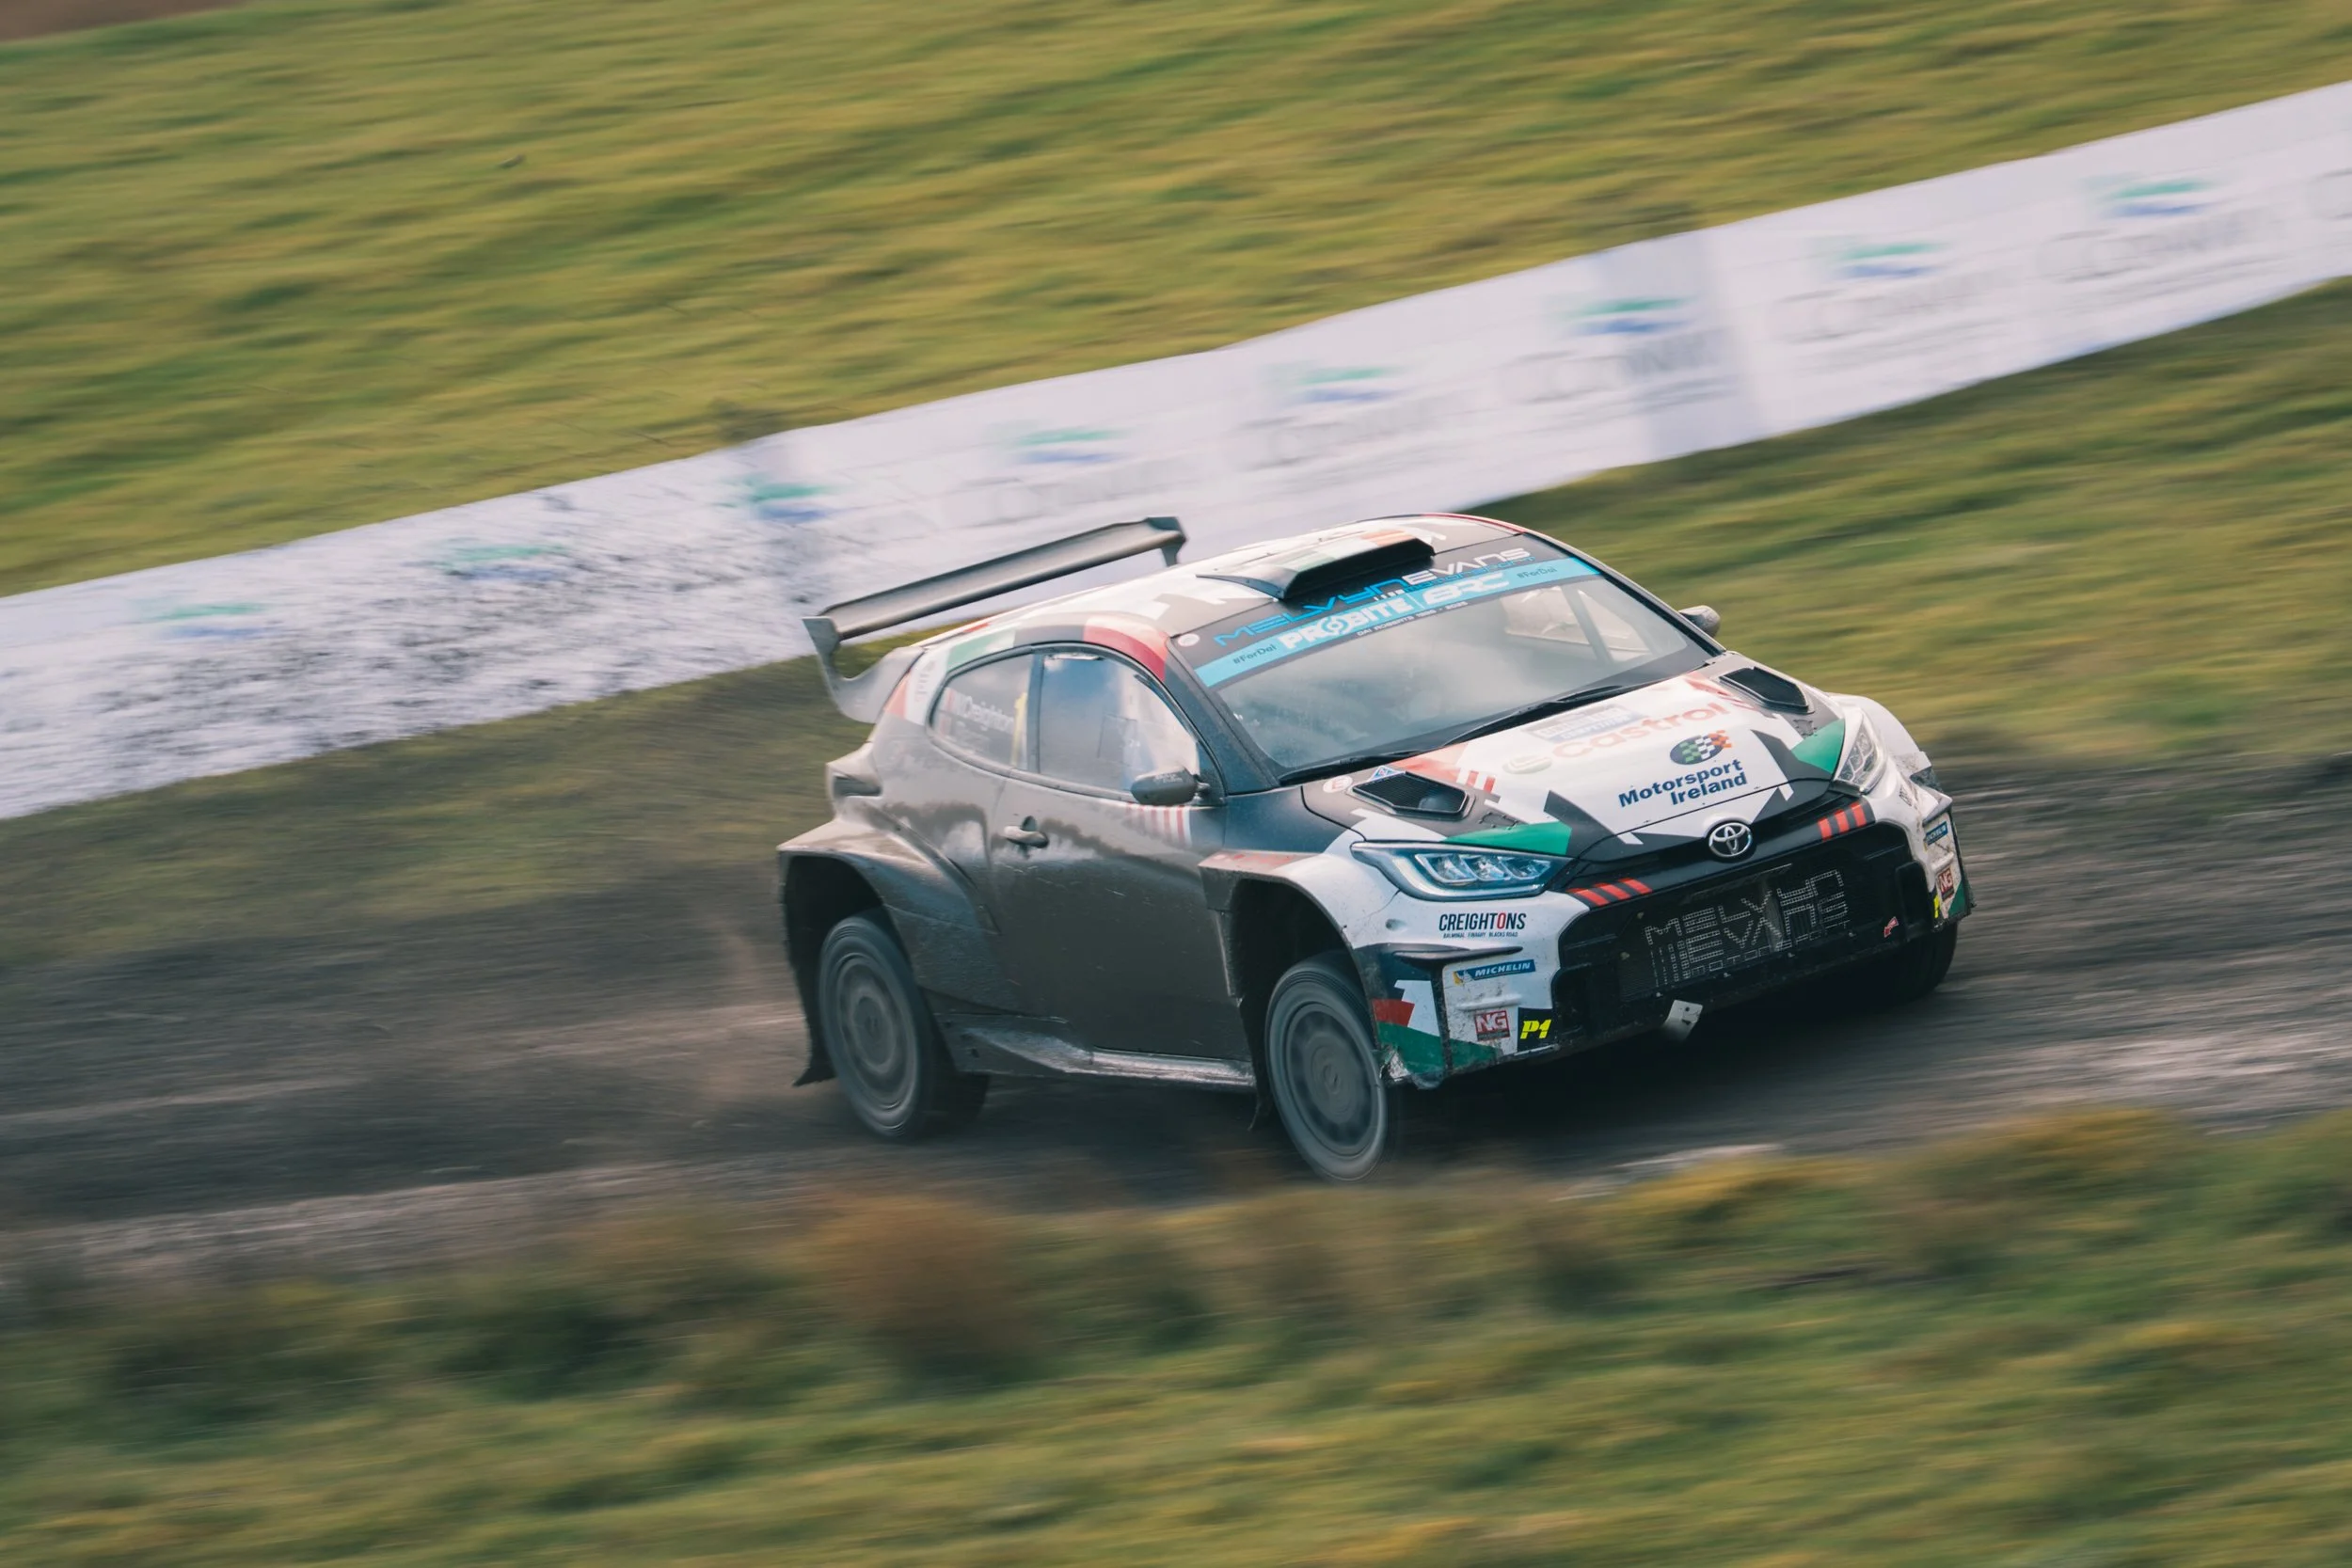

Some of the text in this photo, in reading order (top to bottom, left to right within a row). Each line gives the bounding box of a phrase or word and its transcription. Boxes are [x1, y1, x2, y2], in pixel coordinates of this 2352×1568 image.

[1402, 547, 1531, 585] EVANS
[1277, 596, 1414, 650] PROBITE
[1233, 643, 1278, 664] #ForDai
[1618, 758, 1743, 808] Motorsport
[1670, 771, 1748, 806] Ireland
[1438, 911, 1527, 931] CREIGHTONS
[1474, 962, 1531, 977] MICHELIN
[1476, 1012, 1507, 1032] NG
[1519, 1019, 1551, 1039] P1
